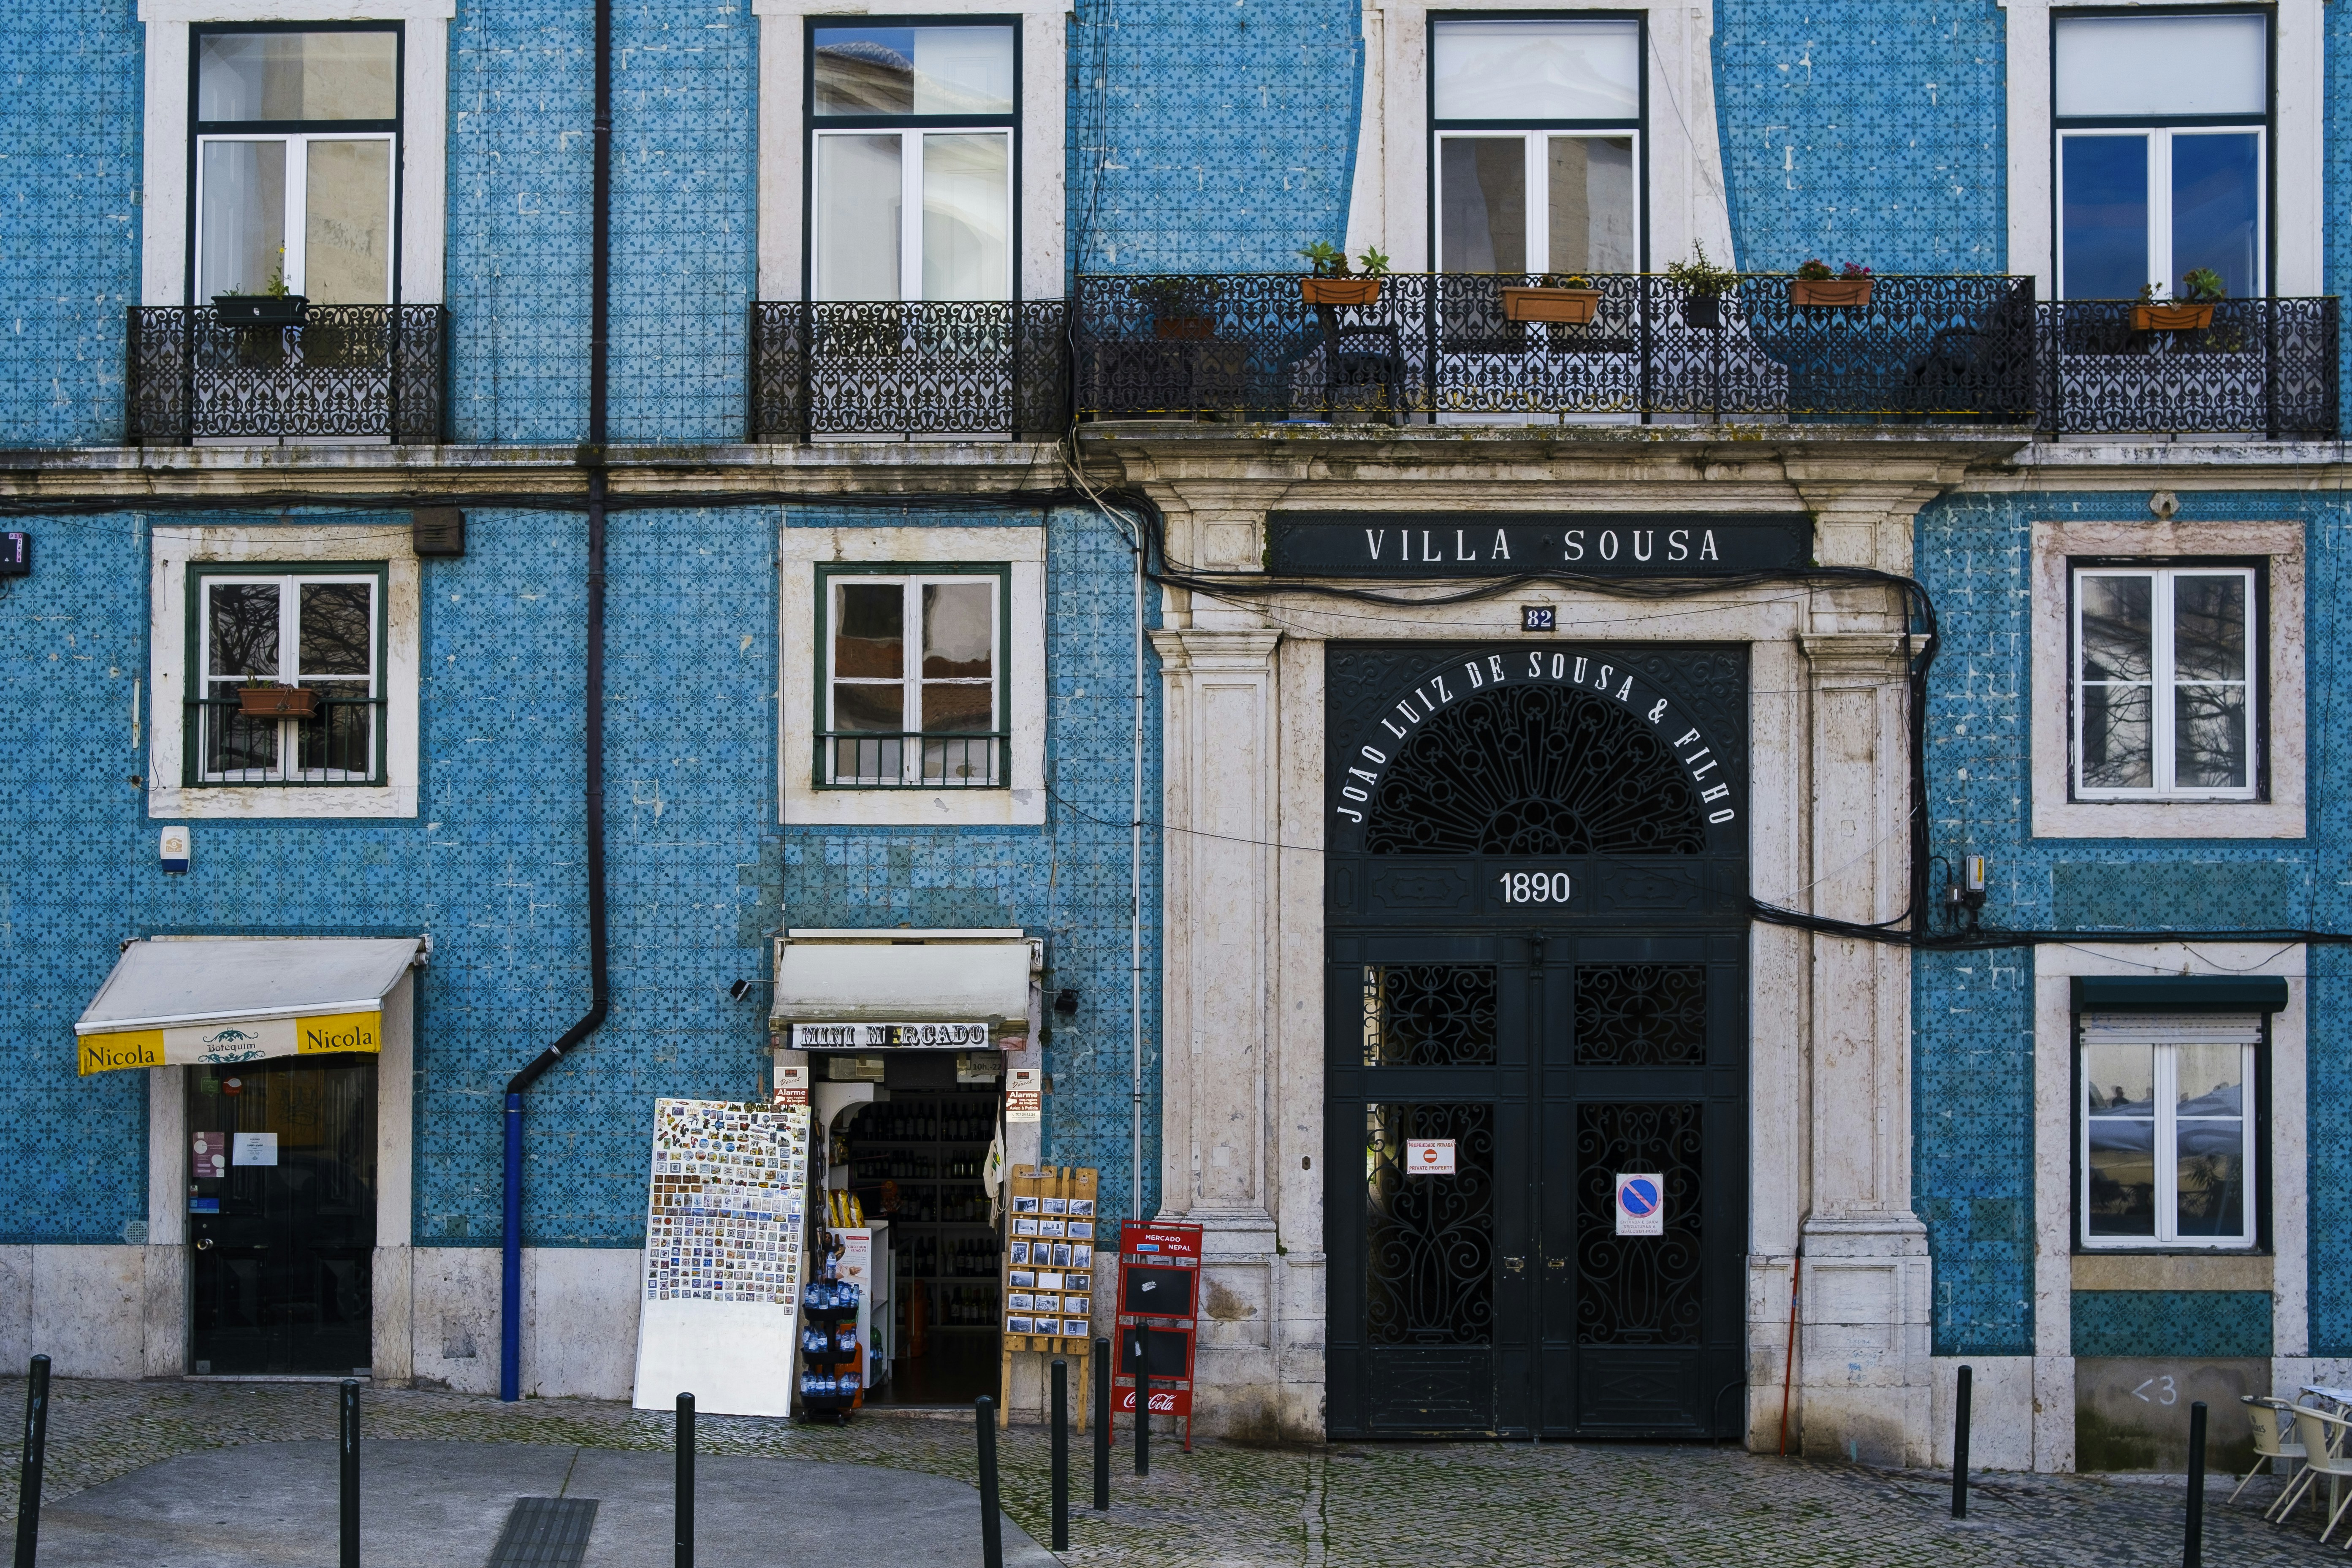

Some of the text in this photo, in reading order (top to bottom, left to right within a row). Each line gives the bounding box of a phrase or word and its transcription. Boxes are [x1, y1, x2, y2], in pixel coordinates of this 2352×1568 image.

[1366, 529, 1718, 561] VILLA SOUSA
[1527, 610, 1551, 627] 82
[1381, 675, 1453, 739] LUIZ
[1465, 655, 1505, 688] DE
[1529, 651, 1633, 702] SOUSA
[1648, 699, 1667, 724] &
[1674, 728, 1734, 824] FILHO
[1500, 873, 1570, 903] 1890
[88, 1026, 372, 1066] Nicola Botequim Nicola
[800, 1026, 855, 1047] MINI
